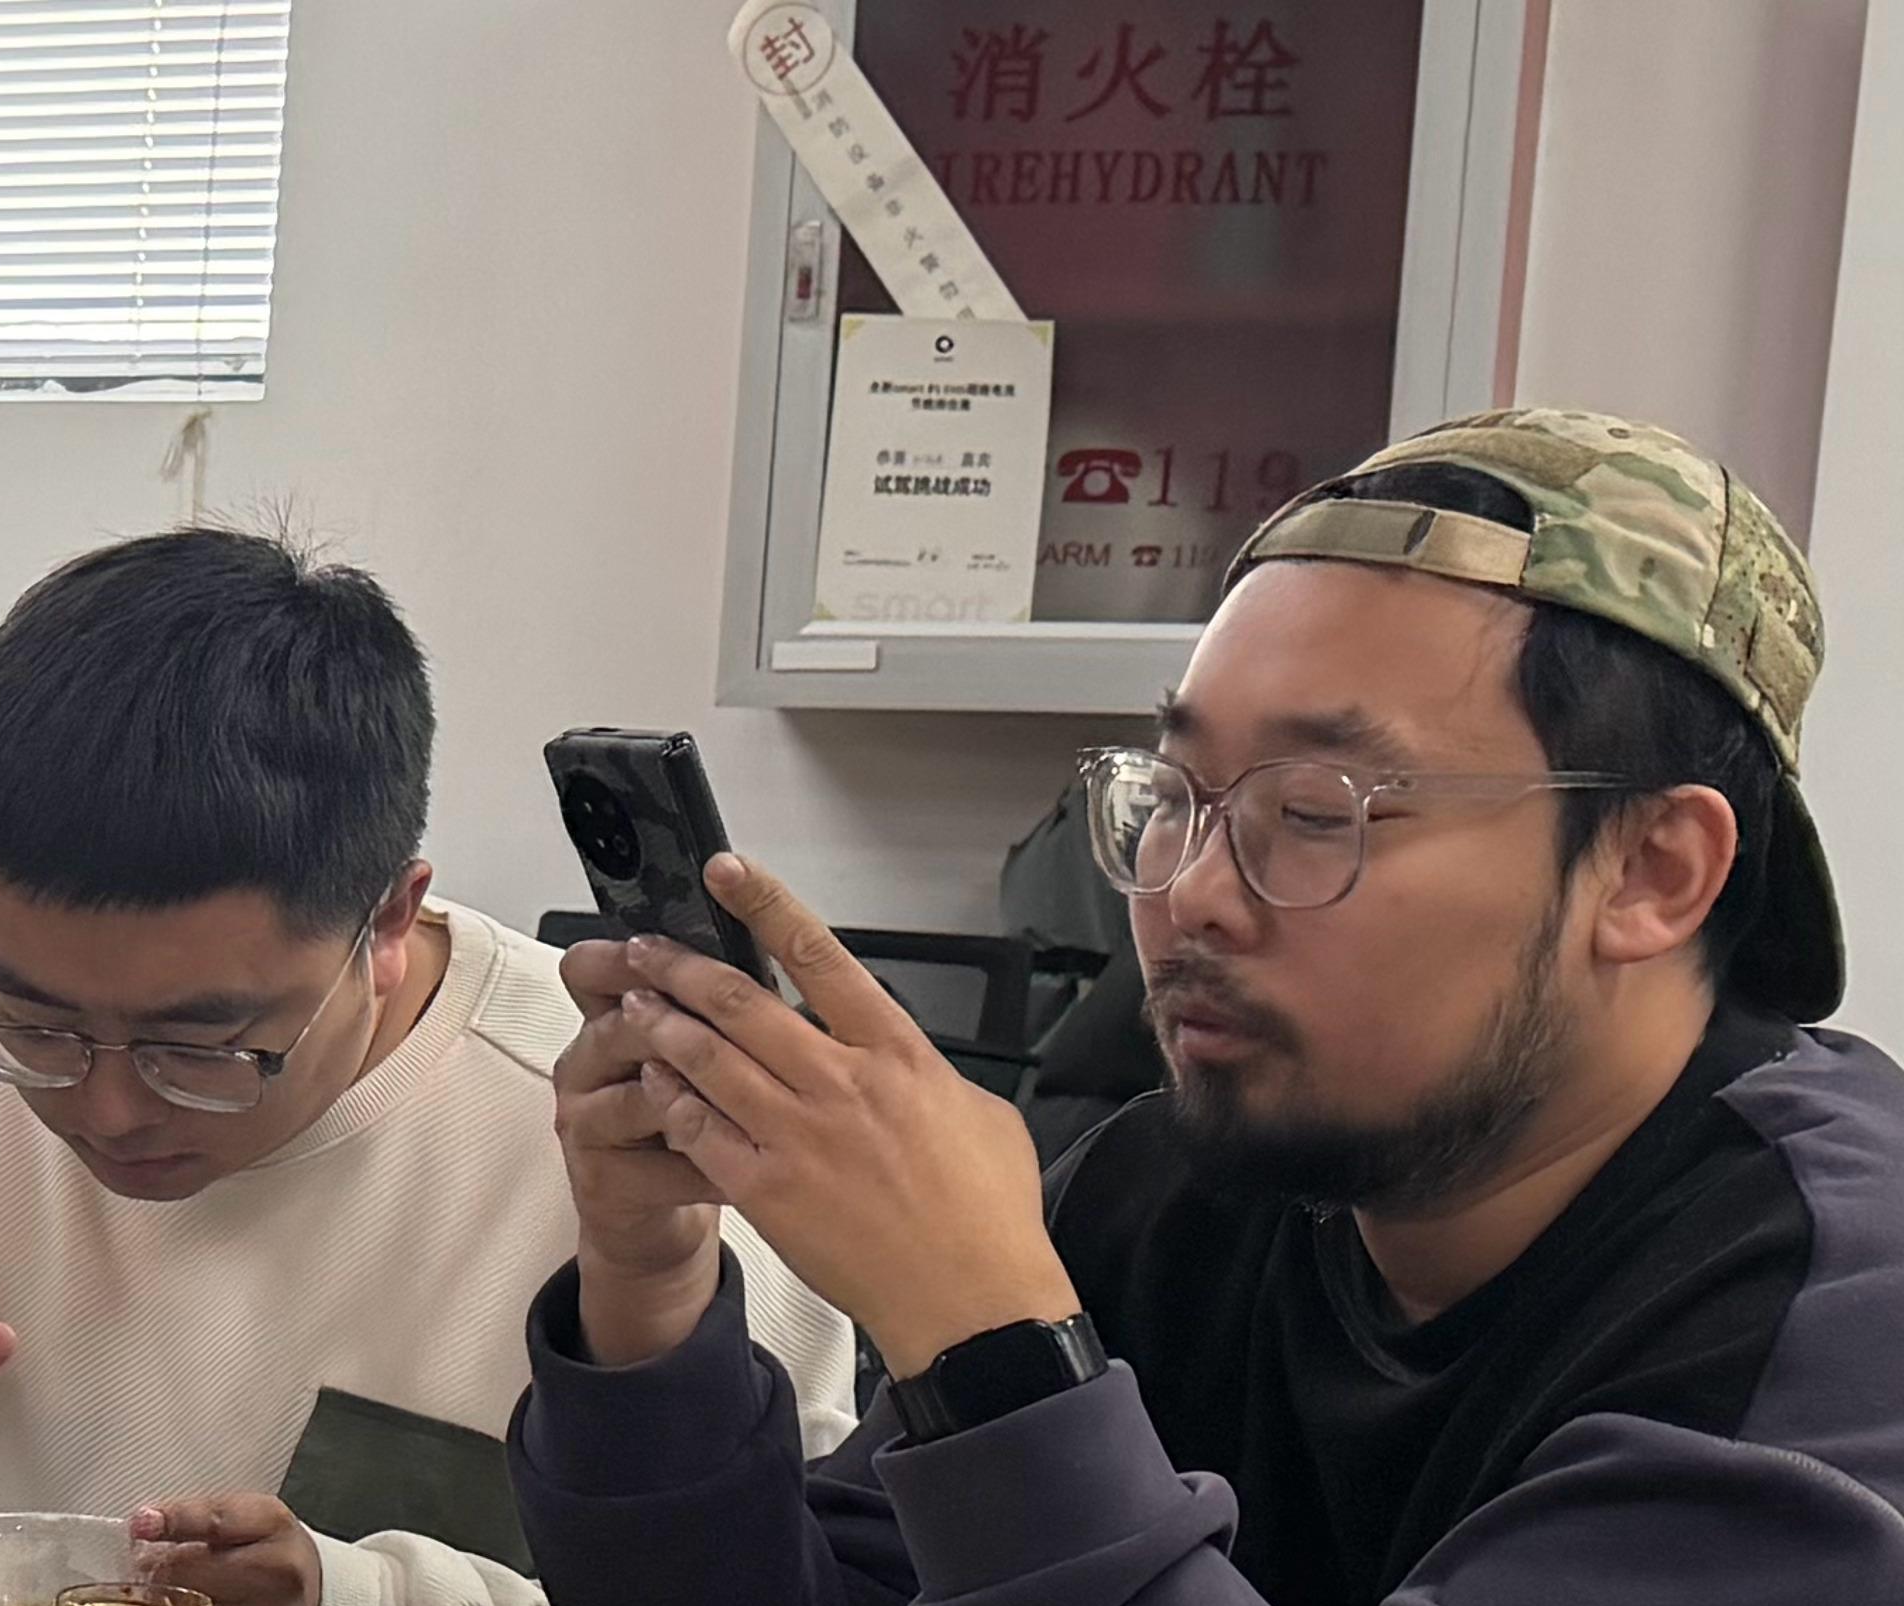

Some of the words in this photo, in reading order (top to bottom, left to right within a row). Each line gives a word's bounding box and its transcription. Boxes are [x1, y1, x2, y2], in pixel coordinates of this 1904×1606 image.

[759, 17, 816, 81] 封
[949, 17, 1300, 122] 消火栓
[939, 150, 1329, 207] IREHYDRANT
[1147, 446, 1299, 513] 119
[1038, 543, 1111, 568] ARM
